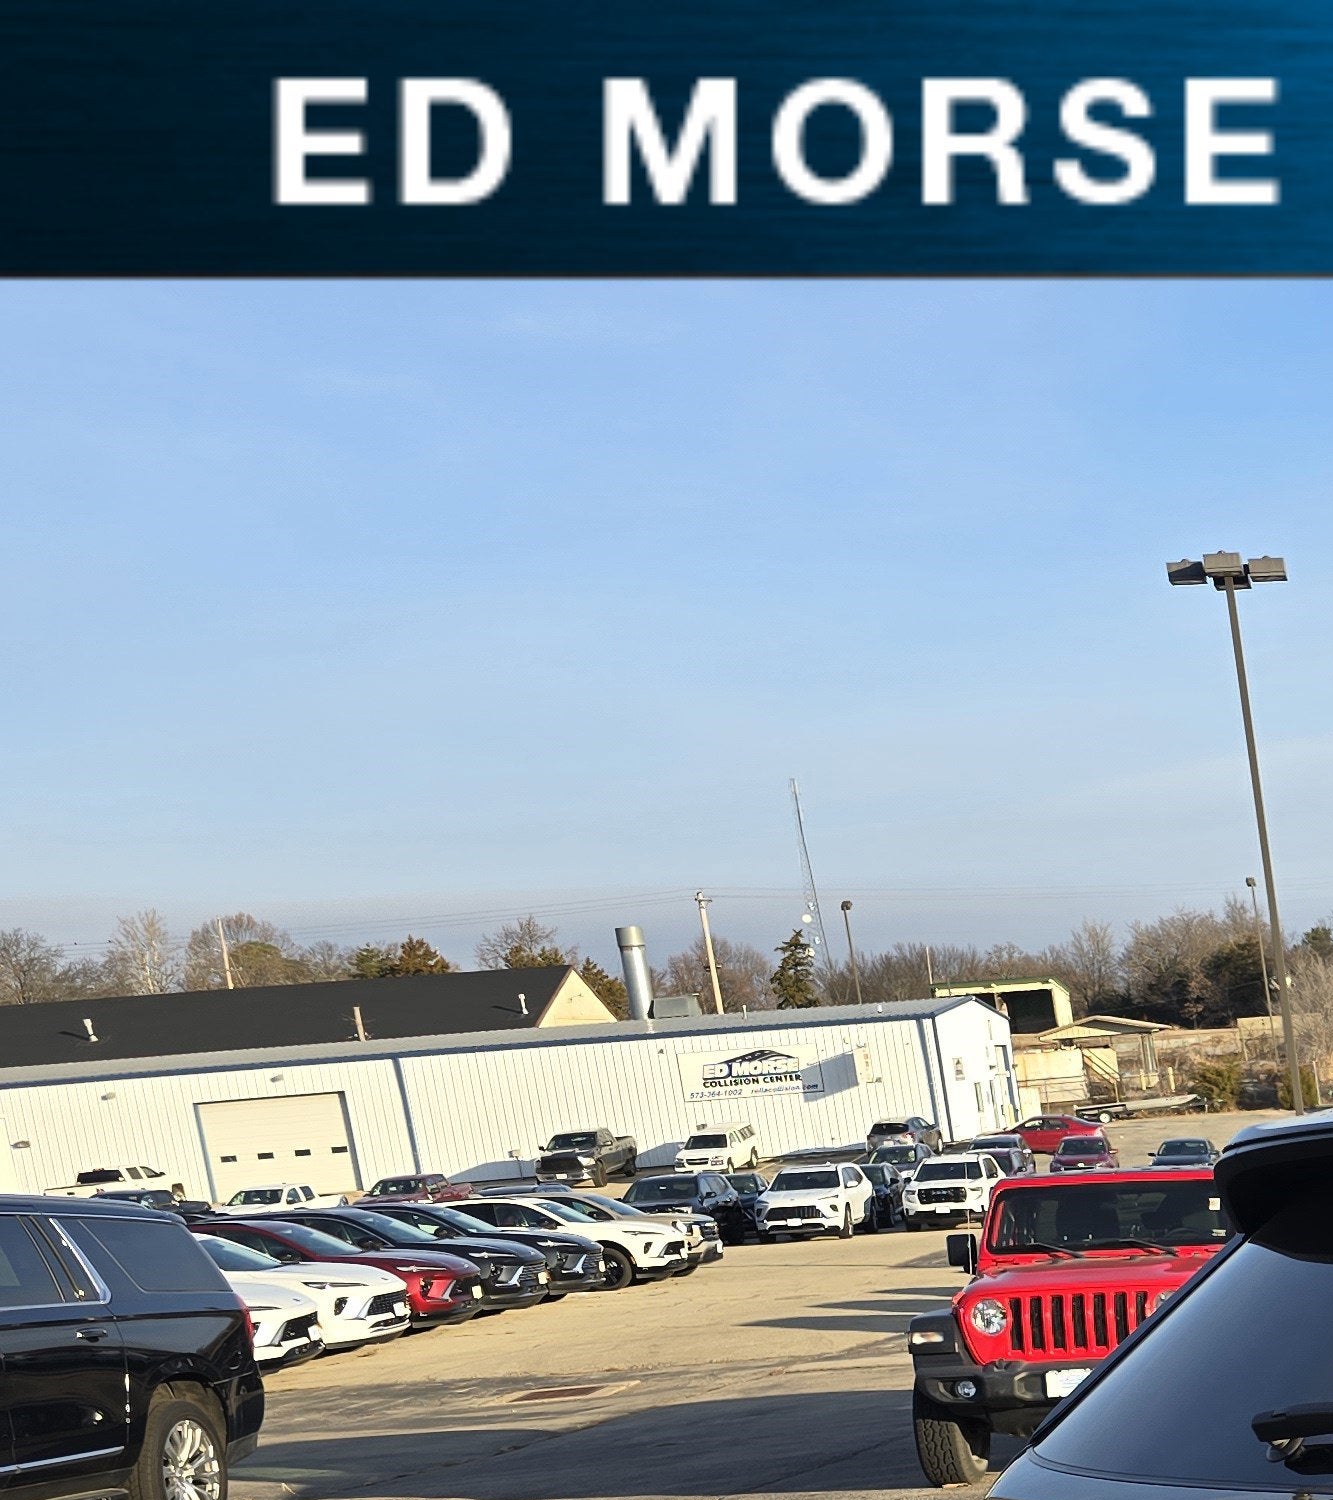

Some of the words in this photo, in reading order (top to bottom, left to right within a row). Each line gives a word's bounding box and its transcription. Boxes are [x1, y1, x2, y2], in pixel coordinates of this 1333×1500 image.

[703, 1063, 730, 1080] ED
[731, 1056, 800, 1078] MORSE
[702, 1076, 760, 1089] COLLISION
[762, 1073, 803, 1084] CENTER
[690, 1088, 743, 1100] 573-364-1002
